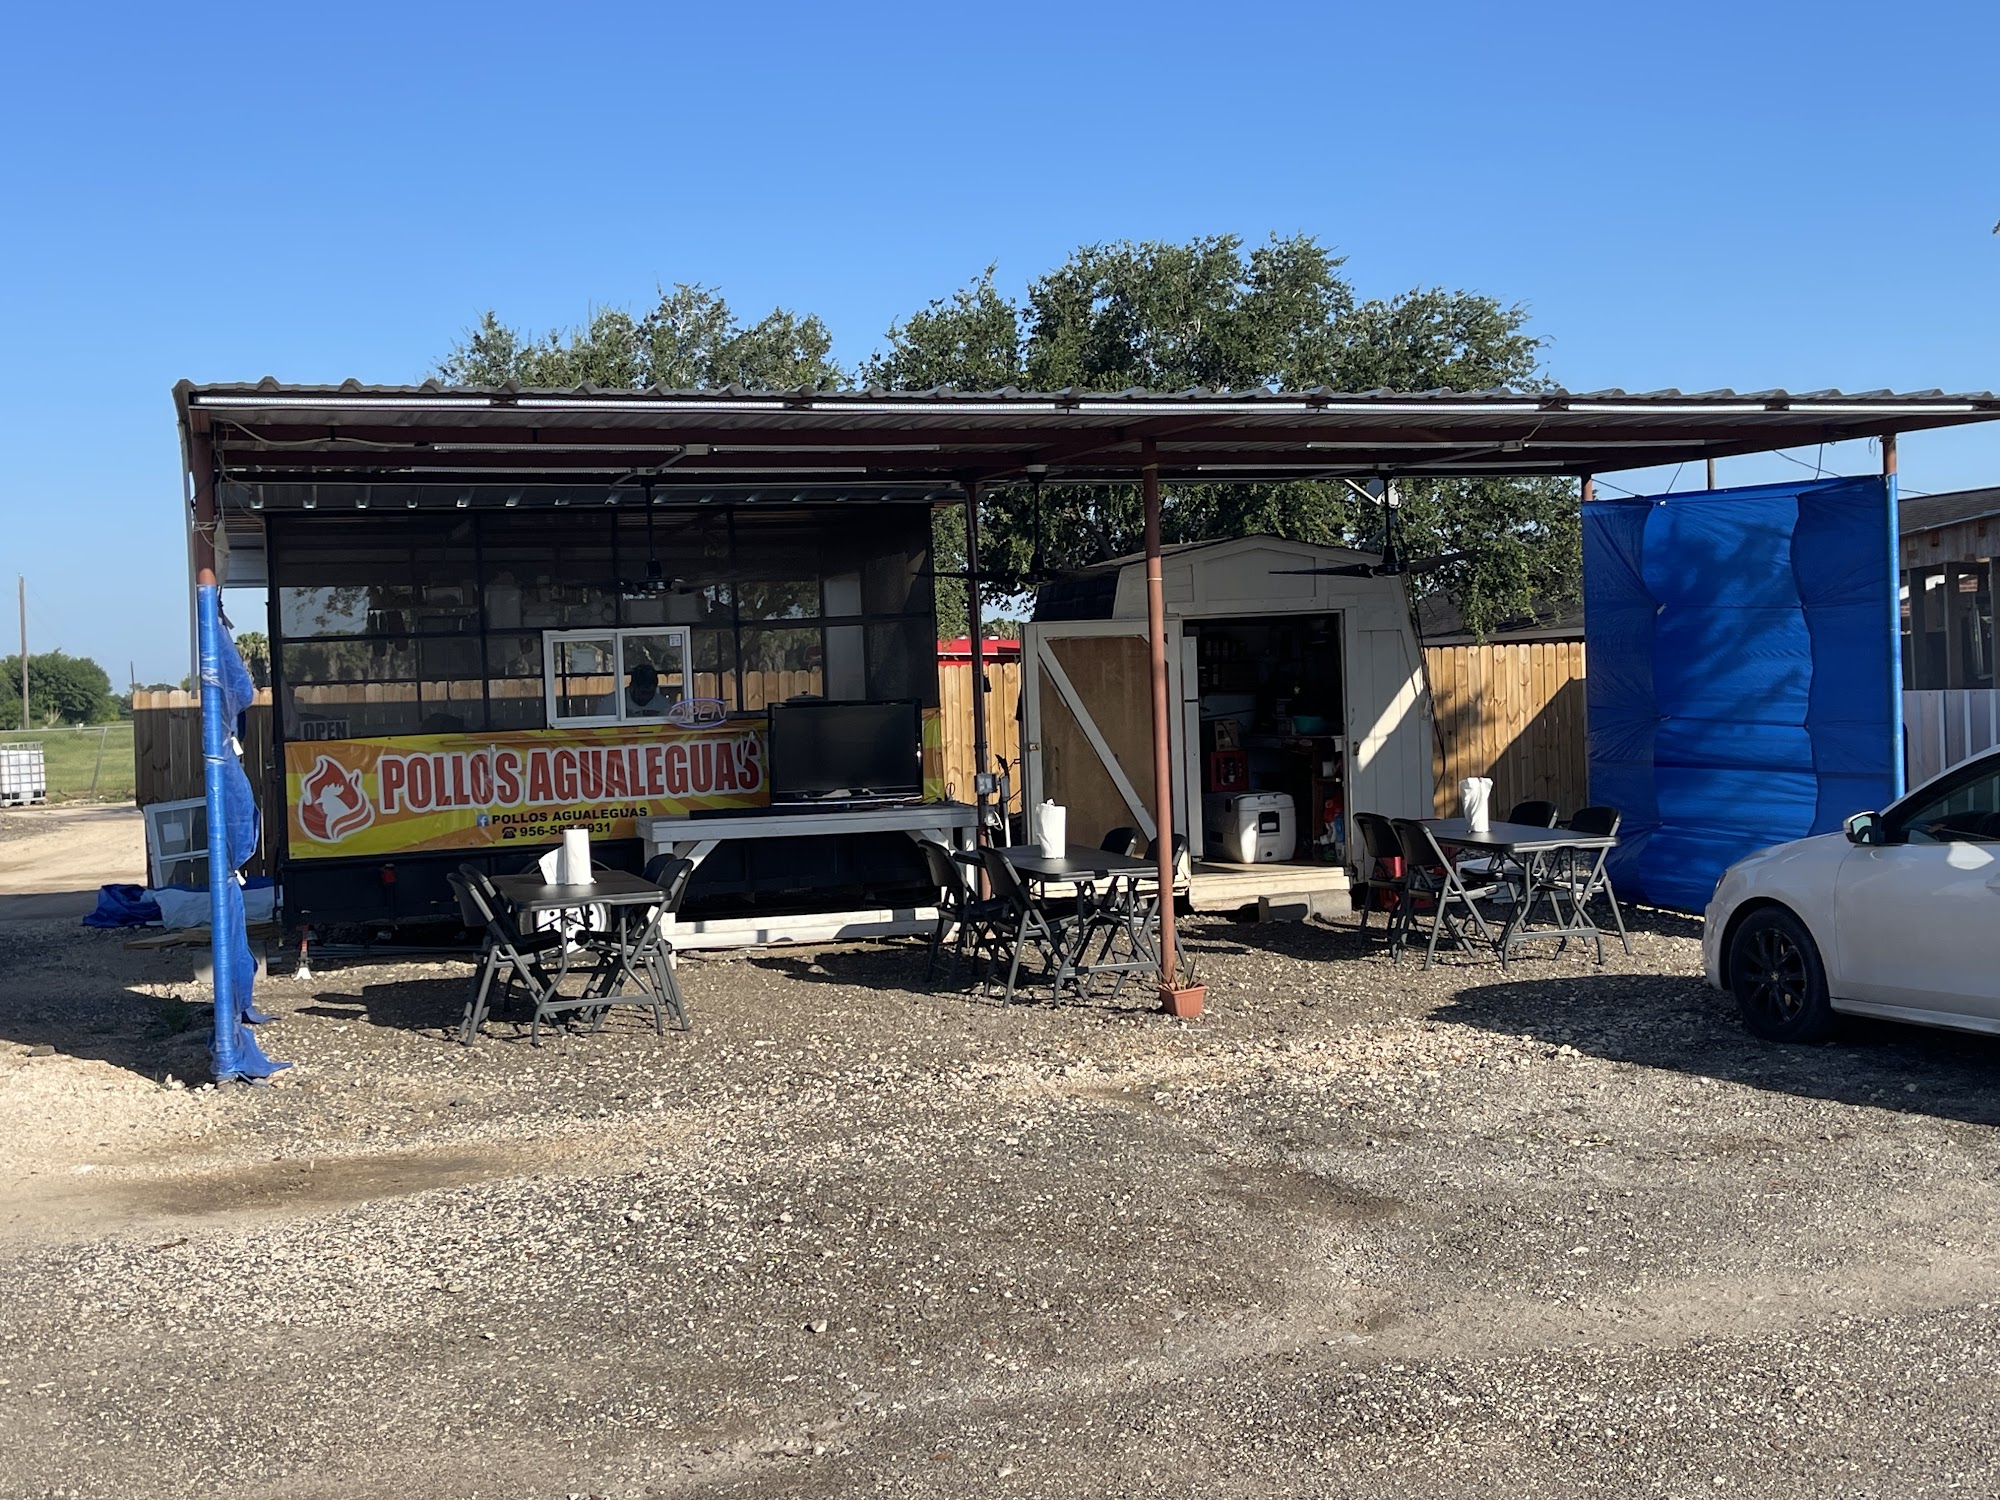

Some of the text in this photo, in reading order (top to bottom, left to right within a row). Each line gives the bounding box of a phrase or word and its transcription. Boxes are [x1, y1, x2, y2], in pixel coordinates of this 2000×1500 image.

[668, 704, 728, 721] OPEN
[303, 721, 347, 741] OPEN
[382, 741, 760, 810] POLLOS AGUALEGUAS
[492, 812, 548, 825] POLLOS
[552, 807, 648, 821] AGUALEGUAS
[520, 822, 611, 837] 956-58931
